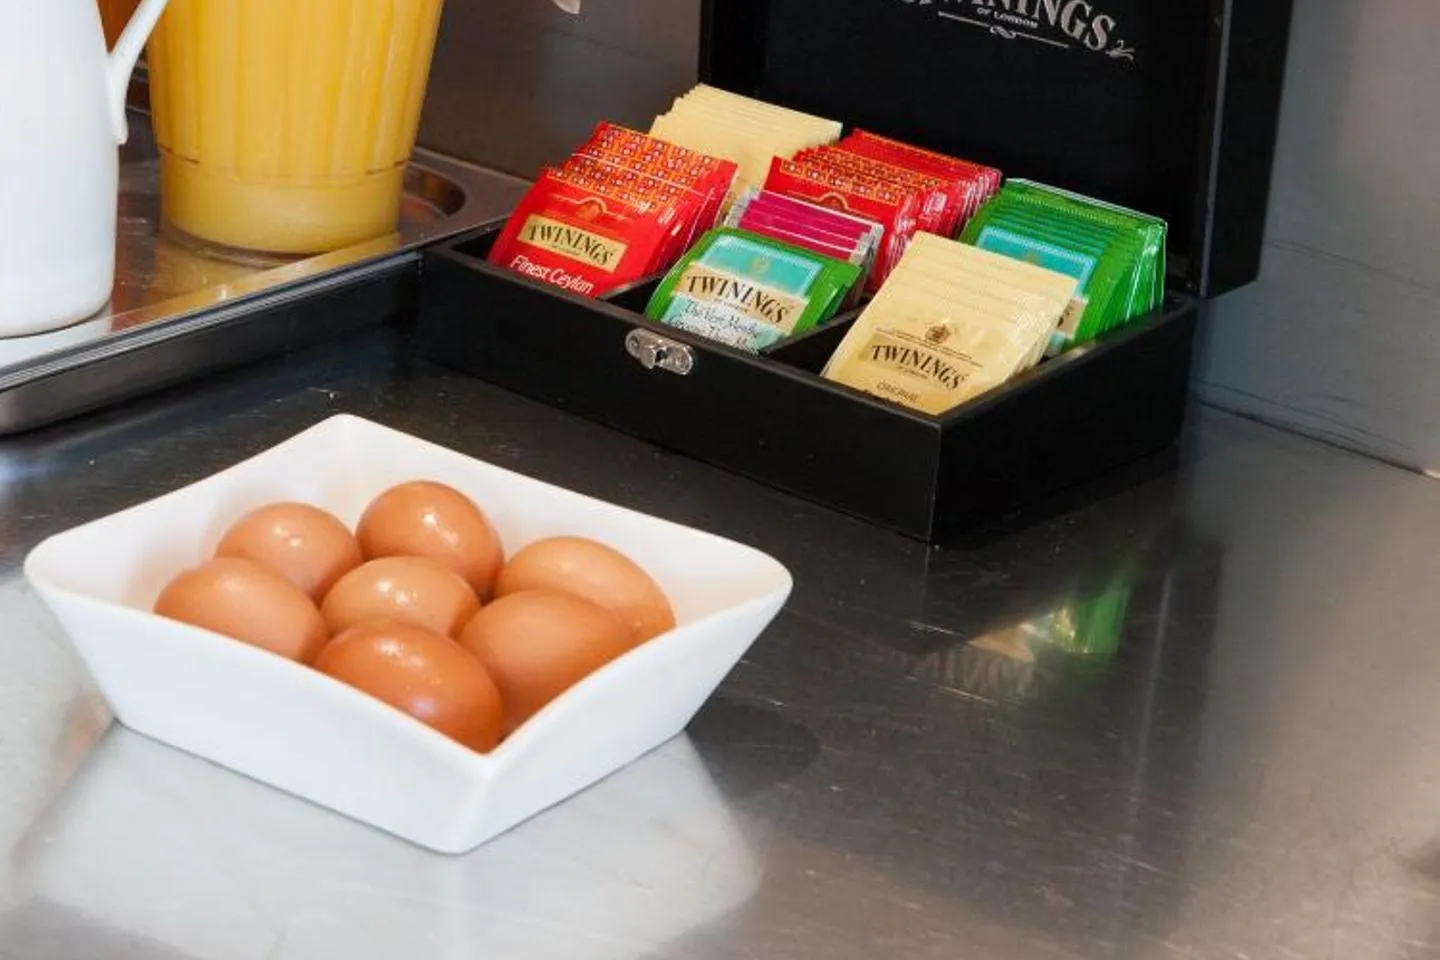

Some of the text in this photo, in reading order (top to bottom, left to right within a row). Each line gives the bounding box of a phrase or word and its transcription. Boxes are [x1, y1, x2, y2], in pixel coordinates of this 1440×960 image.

[528, 224, 614, 266] TWININGS
[509, 254, 595, 295] Finest Ceylon
[687, 275, 792, 324] TWININGS
[872, 344, 970, 391] TWININGS
